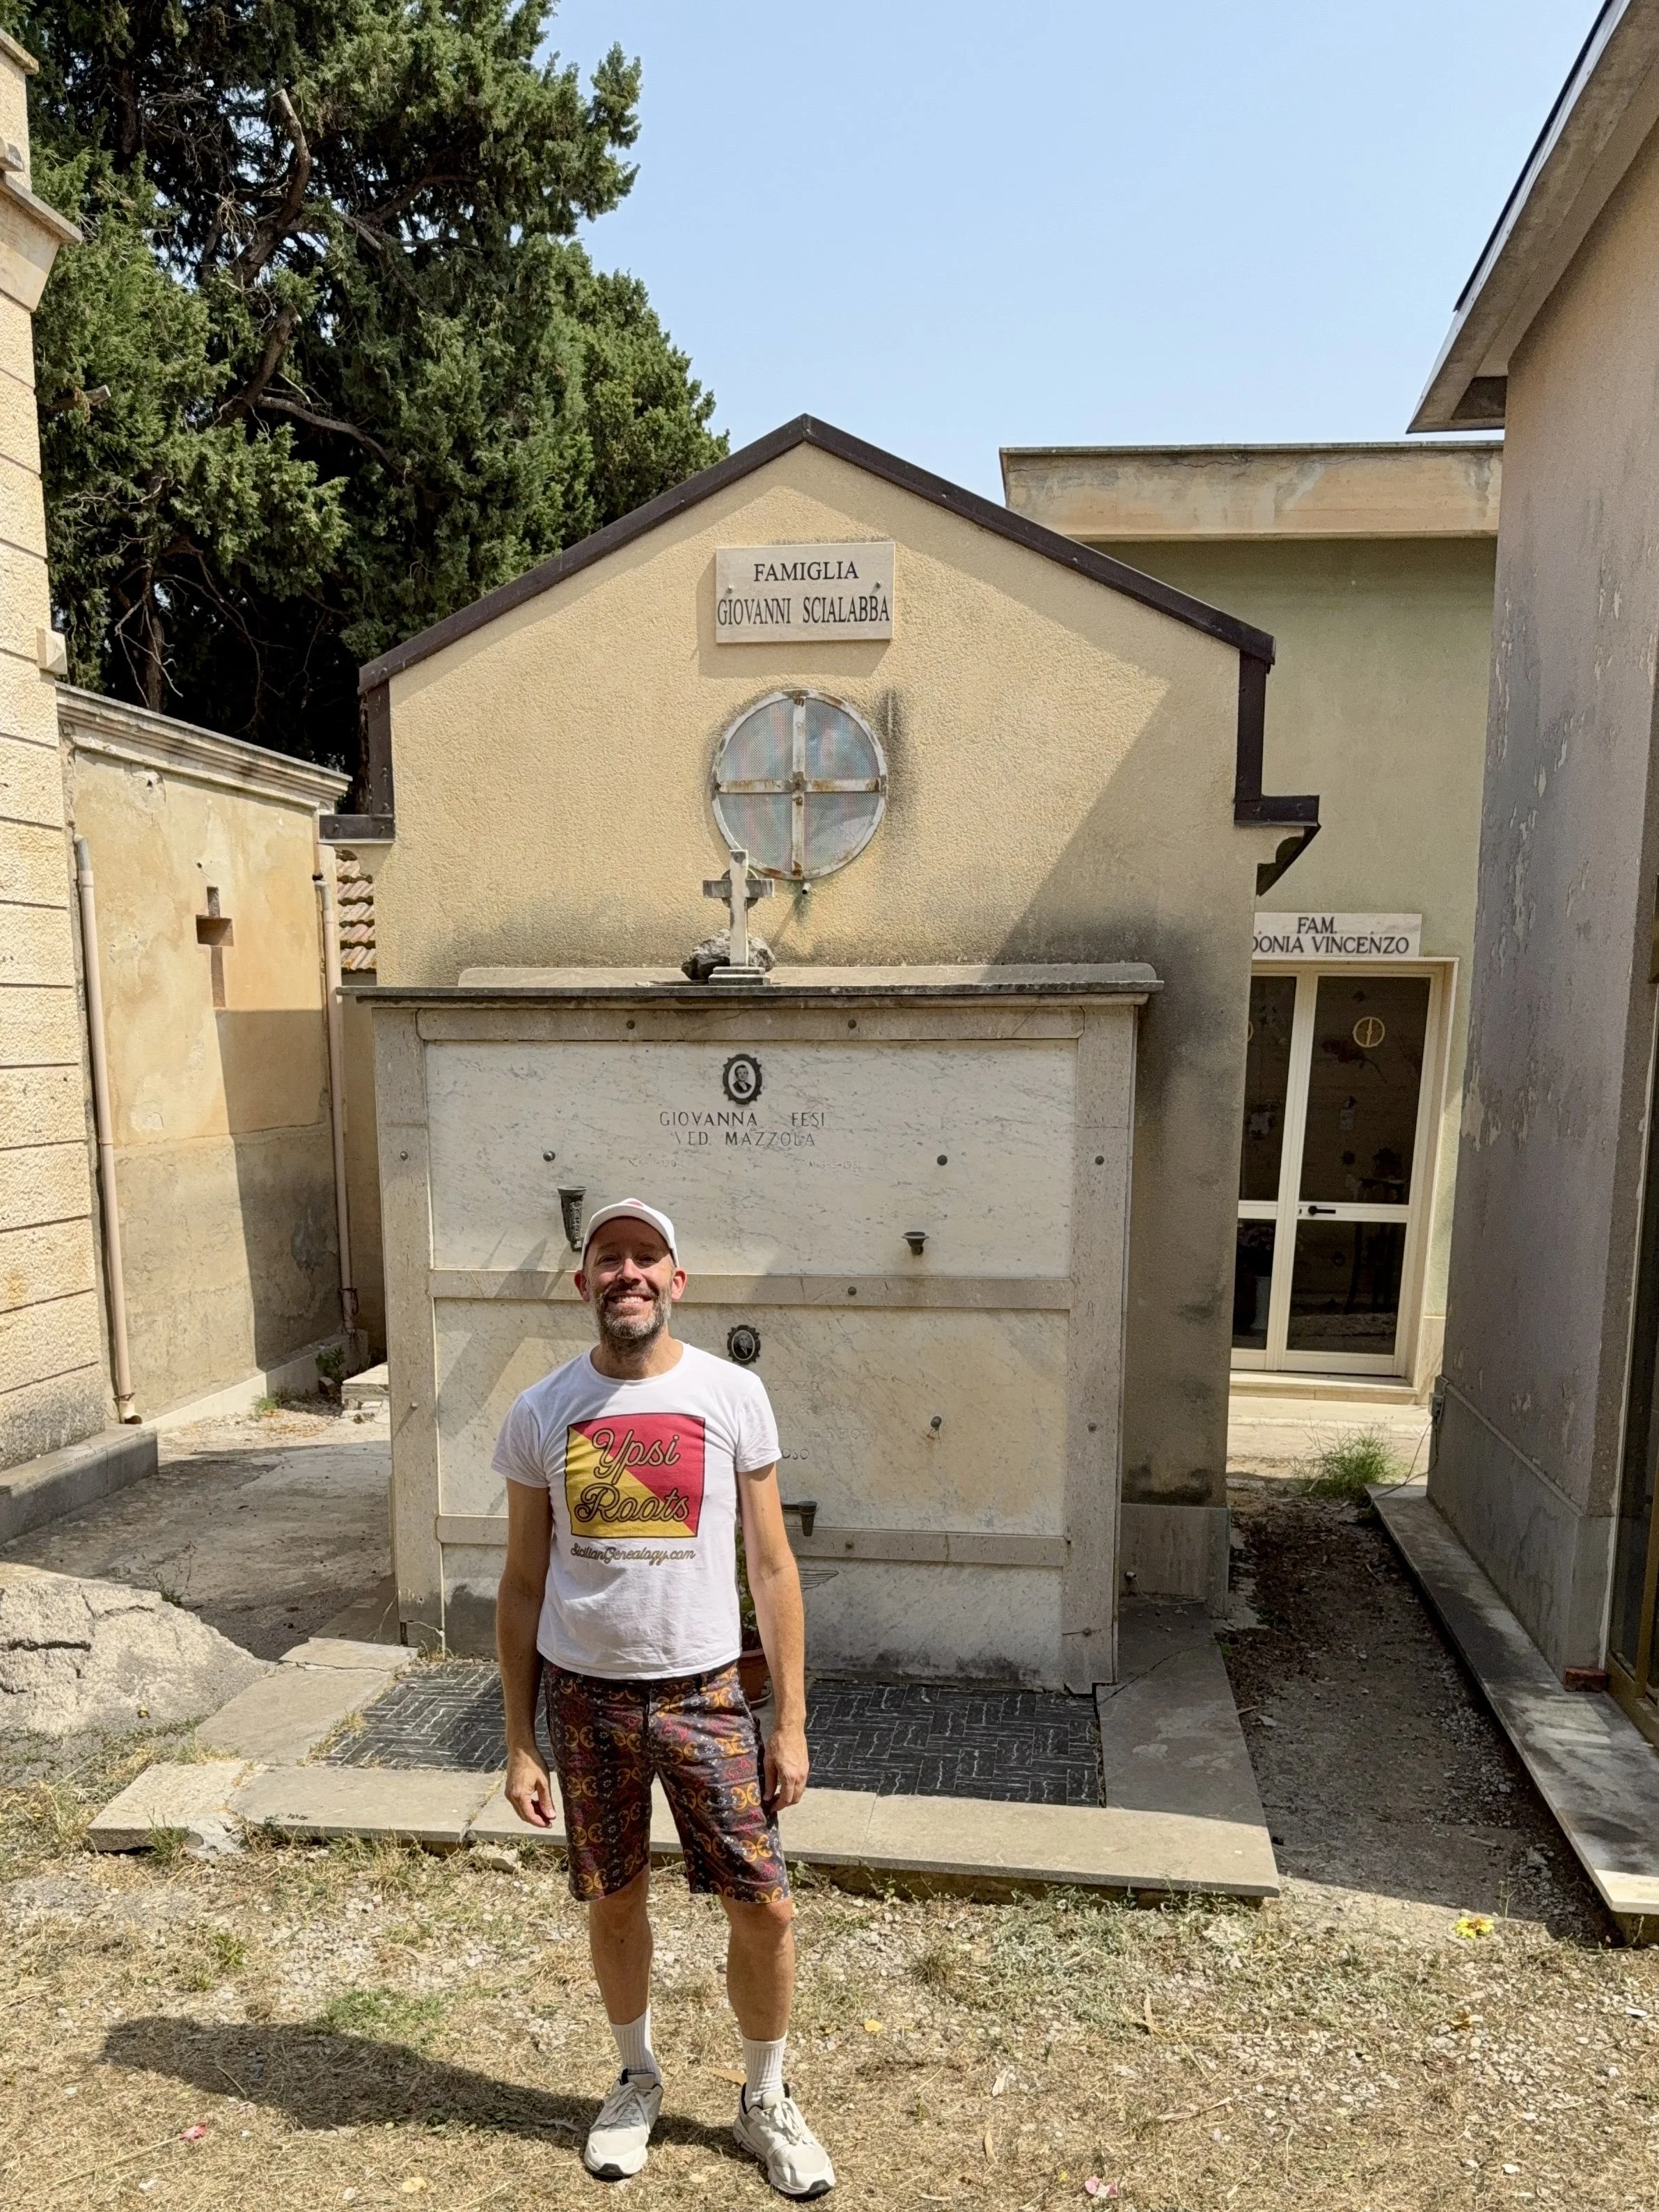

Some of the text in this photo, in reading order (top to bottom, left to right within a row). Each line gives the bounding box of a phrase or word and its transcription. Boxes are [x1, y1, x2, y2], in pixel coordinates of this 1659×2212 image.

[753, 560, 860, 582] FAMIGLIA
[717, 595, 890, 626] GIOVANNI SCIALABBA
[1296, 916, 1337, 934] FAM.
[1312, 936, 1410, 955] VINCENZO
[659, 1111, 825, 1127] GIOVANNA FESI
[725, 1131, 816, 1147] MAZZOLA
[592, 1427, 681, 1485] Ypsi
[574, 1482, 689, 1523] Roots
[570, 1542, 696, 1567] SicilianGenealogy.com
